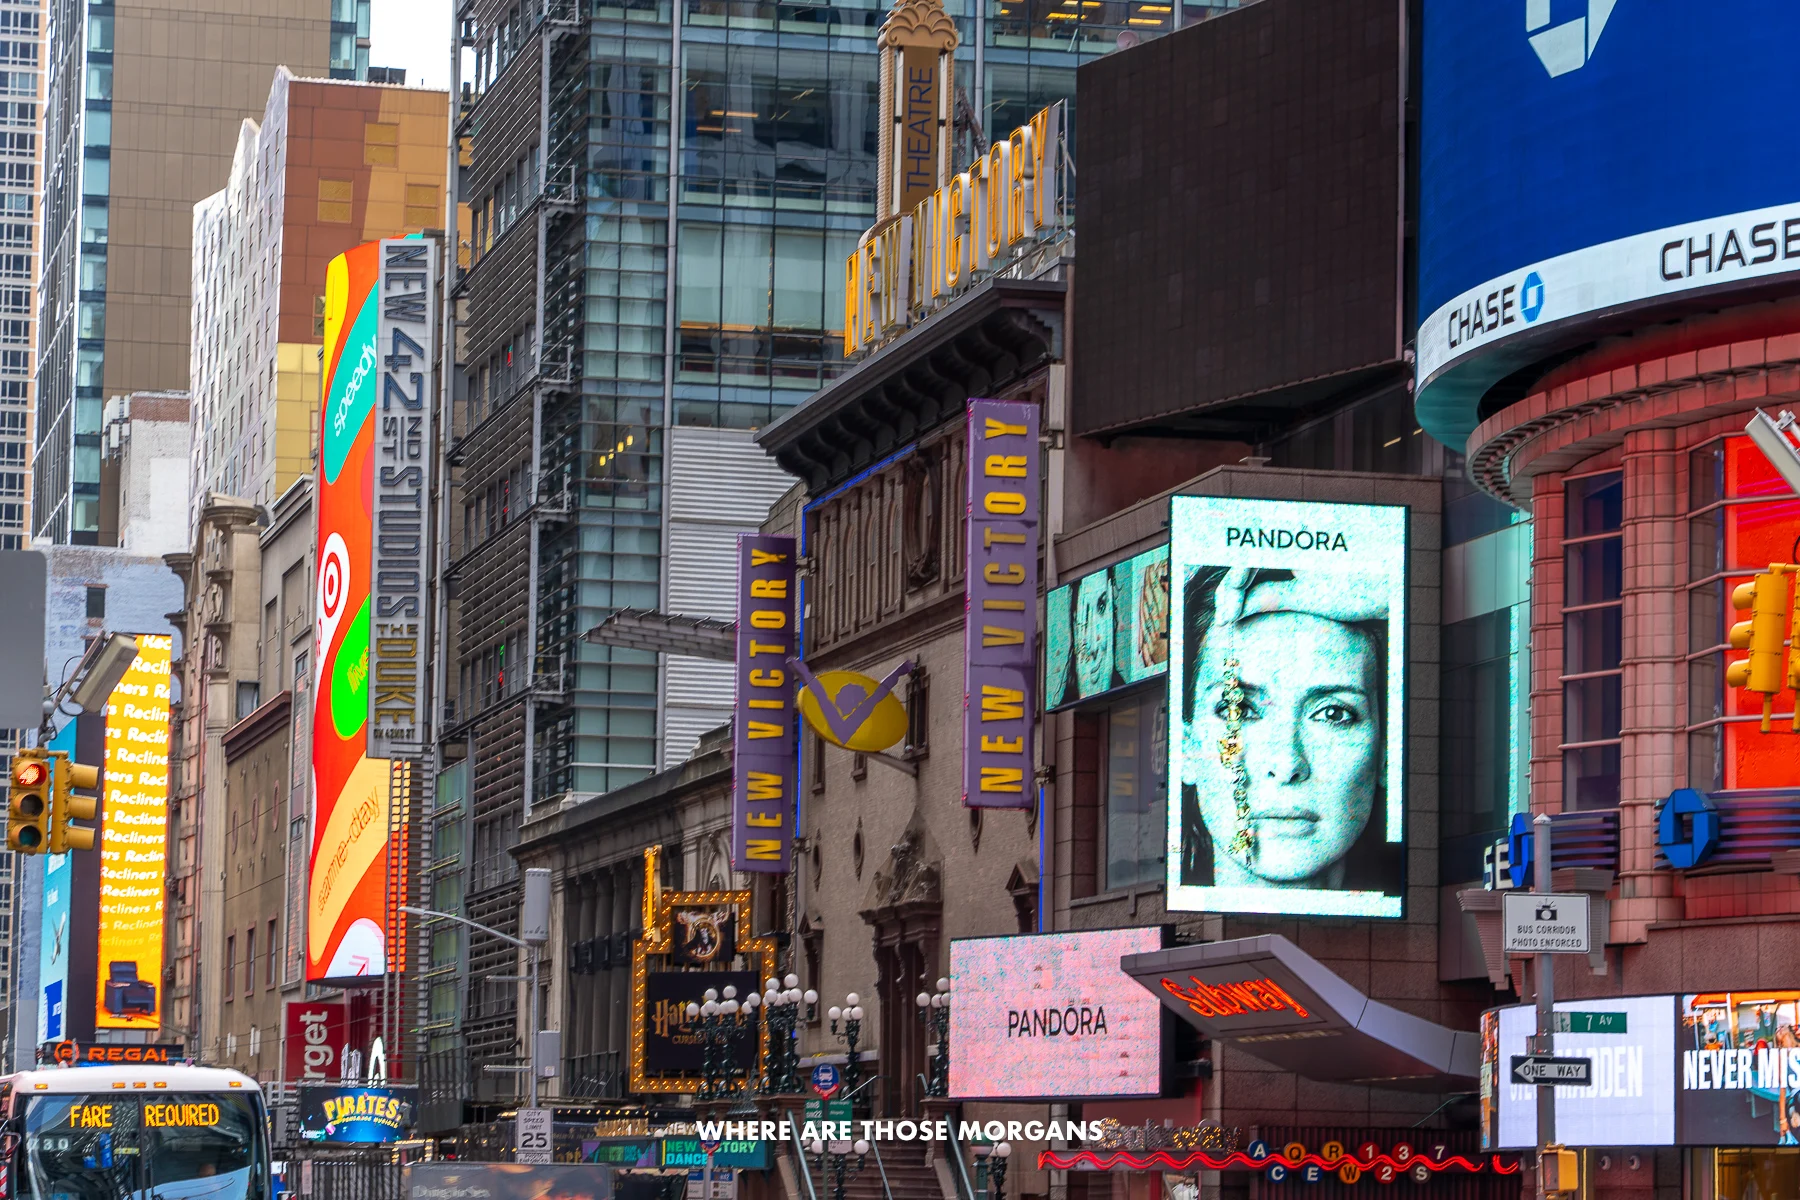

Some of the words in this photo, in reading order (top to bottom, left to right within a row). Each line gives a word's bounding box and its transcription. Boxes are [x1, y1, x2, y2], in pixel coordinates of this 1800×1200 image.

[906, 66, 933, 193] THEATRE
[843, 214, 908, 359] NEW
[912, 105, 1050, 312] VICTORY
[384, 245, 428, 323] NEW
[1448, 283, 1517, 350] CHASE
[334, 334, 378, 437] speedy
[376, 466, 423, 617] STUDIOS
[982, 417, 1028, 648] VICTORY
[1226, 527, 1348, 552] PANDORA
[747, 548, 788, 740] VICTORY
[374, 638, 417, 725] DUKE
[980, 684, 1025, 793] NEW
[745, 770, 783, 861] NEW
[103, 829, 166, 844] Recliners
[101, 866, 158, 881] Recliners
[102, 885, 160, 898] Recliners
[100, 902, 150, 915] ecliners
[1517, 925, 1534, 935] BUS
[1536, 925, 1577, 935] CORRIDOR
[1511, 938, 1538, 948] PHOTO
[1540, 938, 1583, 948] ENFORCED
[651, 998, 700, 1038] Har
[1008, 1006, 1108, 1038] PANDORA
[1585, 1014, 1594, 1031] 7
[87, 1047, 169, 1062] REGAL
[1523, 1064, 1546, 1076] ONE
[1556, 1064, 1581, 1077] WAY
[1683, 1049, 1753, 1090] NEVER
[70, 1104, 113, 1128] FARE
[145, 1103, 220, 1127] REQUIRED
[521, 1132, 548, 1148] 25
[667, 1141, 697, 1152] NEW
[1253, 1143, 1267, 1158] A
[1328, 1145, 1340, 1159] R
[1366, 1144, 1374, 1158] 1
[1398, 1146, 1409, 1160] 3
[1435, 1145, 1445, 1159] 7
[666, 1153, 708, 1165] DANCE
[1271, 1166, 1284, 1180] C
[1307, 1166, 1319, 1181] E
[1343, 1166, 1356, 1181] W
[1381, 1166, 1393, 1180] 2
[1416, 1166, 1428, 1180] S
